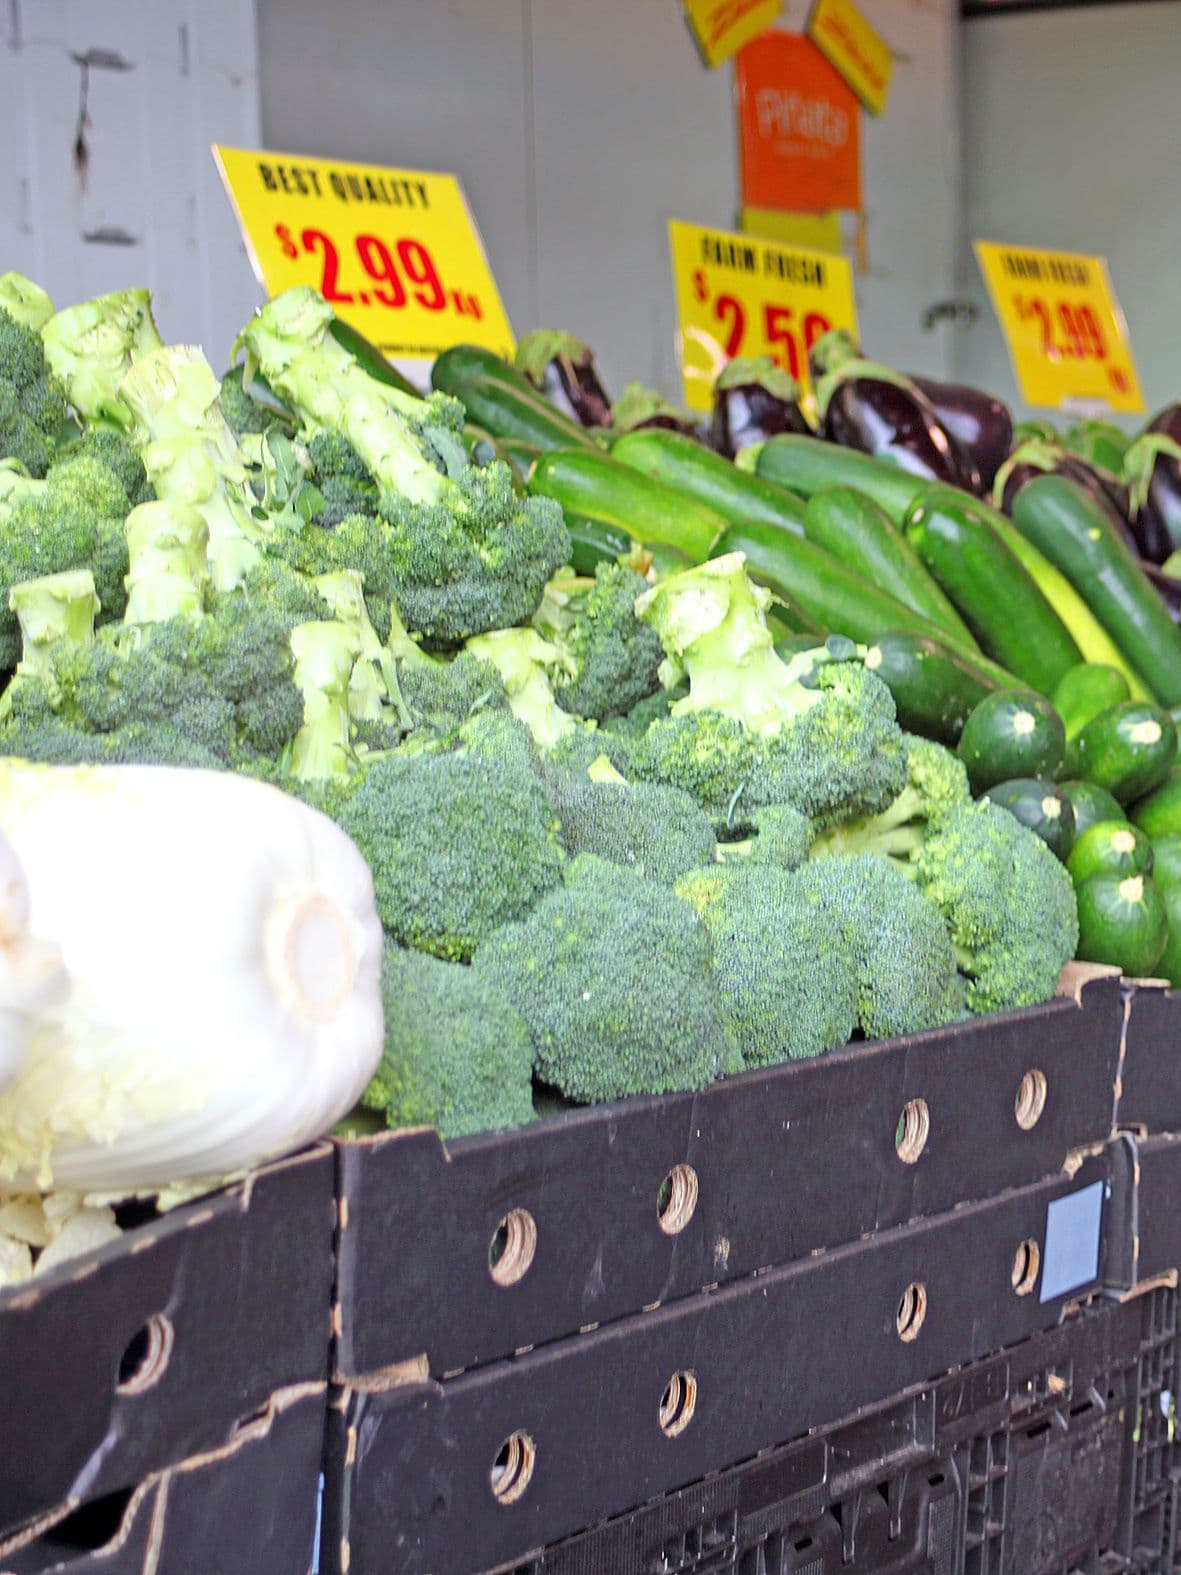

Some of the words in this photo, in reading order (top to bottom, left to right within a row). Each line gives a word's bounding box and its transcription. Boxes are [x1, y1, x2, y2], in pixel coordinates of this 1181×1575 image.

[258, 162, 323, 198] BEST
[328, 171, 430, 209] QUALITY
[763, 249, 826, 288] FRESH
